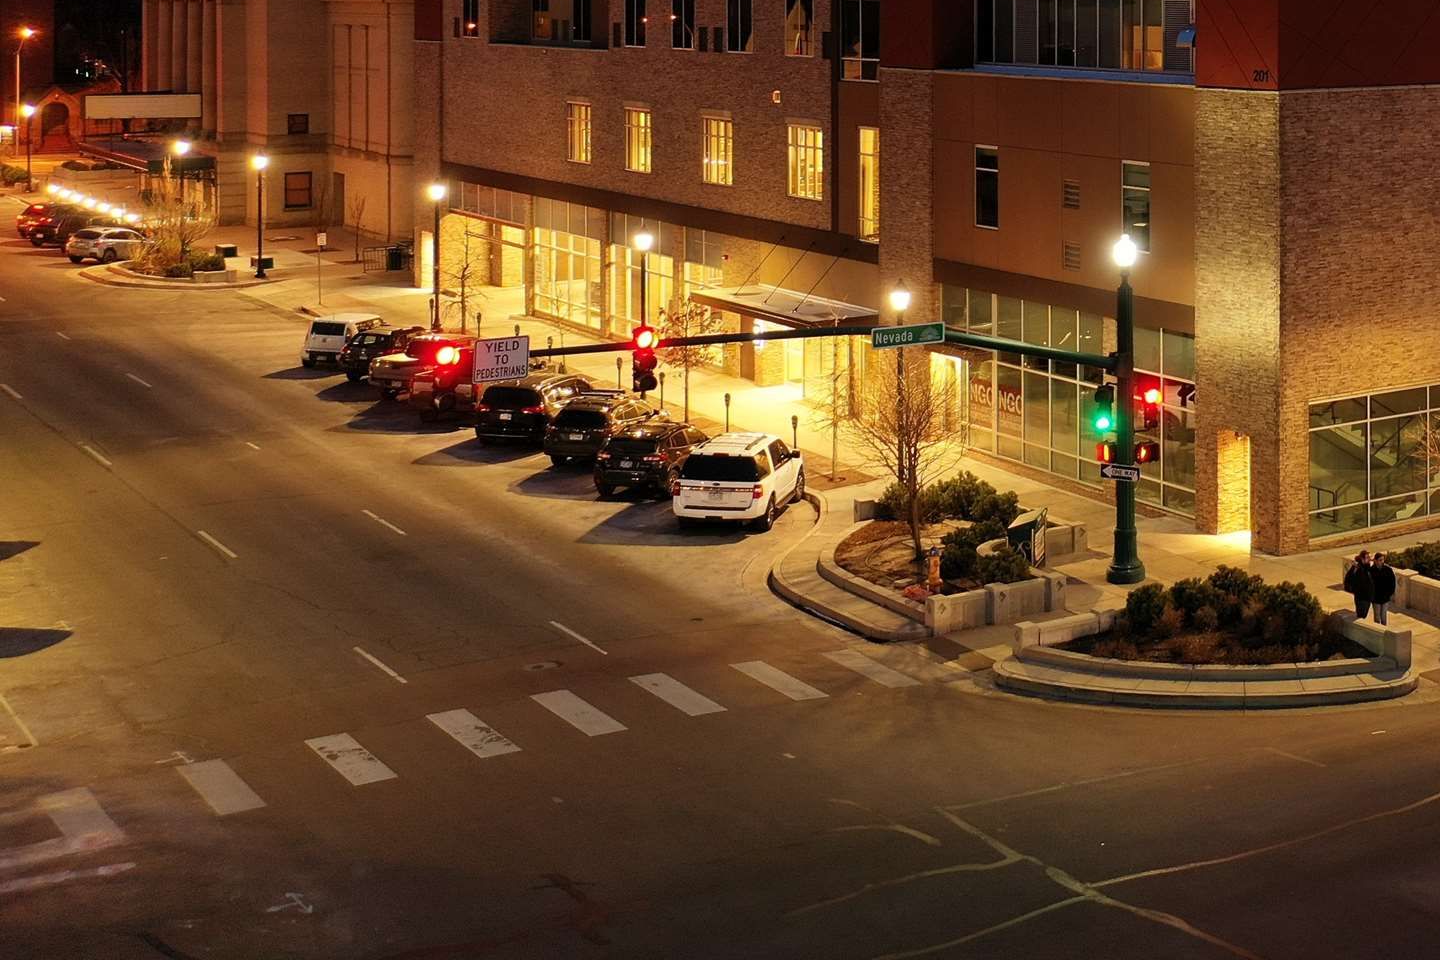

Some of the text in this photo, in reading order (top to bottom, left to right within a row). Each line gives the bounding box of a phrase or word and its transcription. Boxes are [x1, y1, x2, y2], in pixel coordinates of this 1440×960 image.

[1253, 70, 1270, 82] 201
[874, 330, 913, 345] Nevada
[485, 340, 520, 353] YIELD
[494, 354, 509, 366] TO
[476, 365, 526, 380] PEDESTRIANS
